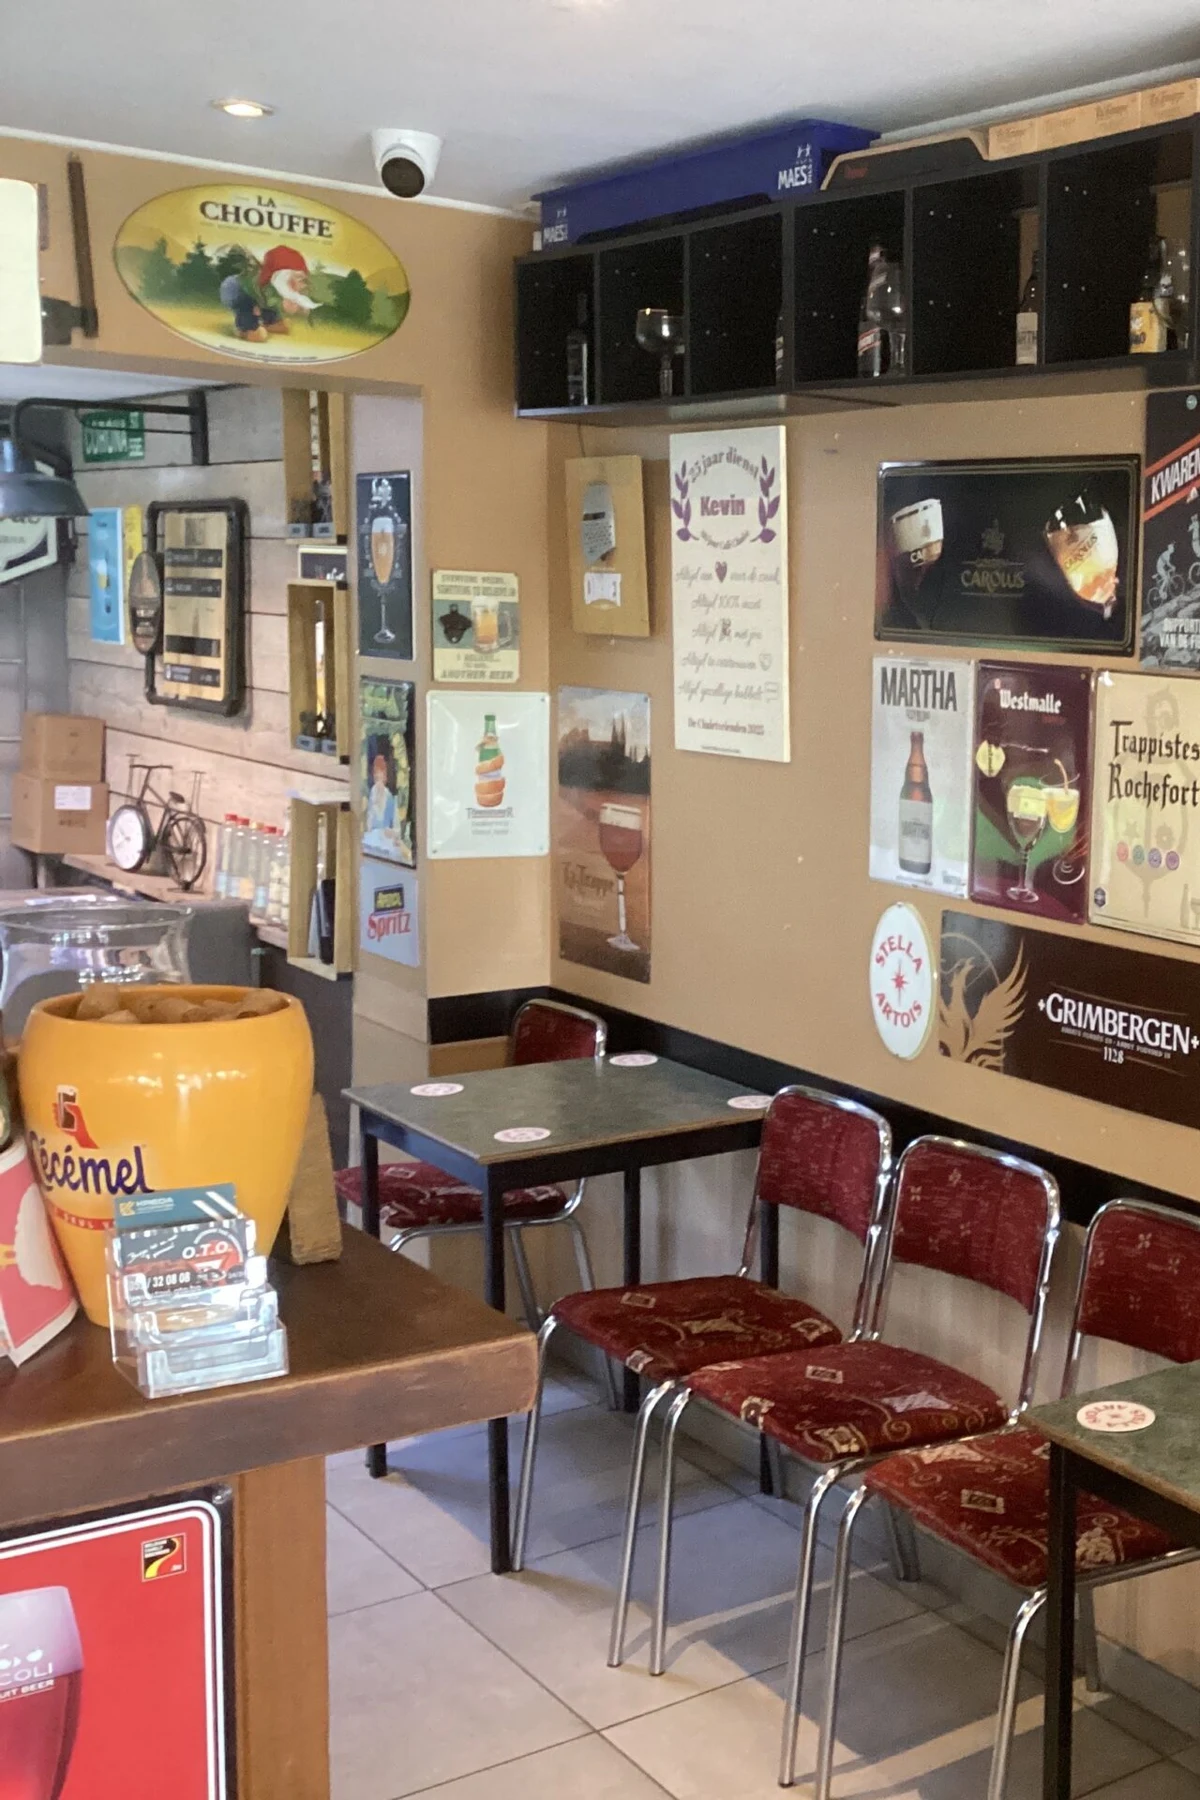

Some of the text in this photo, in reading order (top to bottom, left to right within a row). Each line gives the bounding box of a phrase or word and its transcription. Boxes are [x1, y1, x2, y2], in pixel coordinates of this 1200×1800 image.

[778, 165, 807, 190] MAES
[257, 195, 276, 208] LA
[200, 200, 333, 238] CHOUFFE
[702, 455, 724, 475] jaar
[726, 447, 759, 480] dienst
[700, 494, 745, 516] Kevin
[1160, 634, 1176, 649] VAN
[880, 666, 957, 712] MARTHA
[1000, 690, 1062, 714] Westmalle
[1110, 720, 1200, 763] Trappistes
[1108, 763, 1199, 809] Rochefort
[368, 913, 410, 942] Spritz
[875, 933, 922, 975] STELLA
[876, 991, 922, 1028] ARTOIS
[1046, 993, 1191, 1055] GRIMBERGEN
[1103, 1047, 1124, 1065] 1128
[153, 1274, 164, 1287] 32
[21, 1679, 54, 1694] BEER
